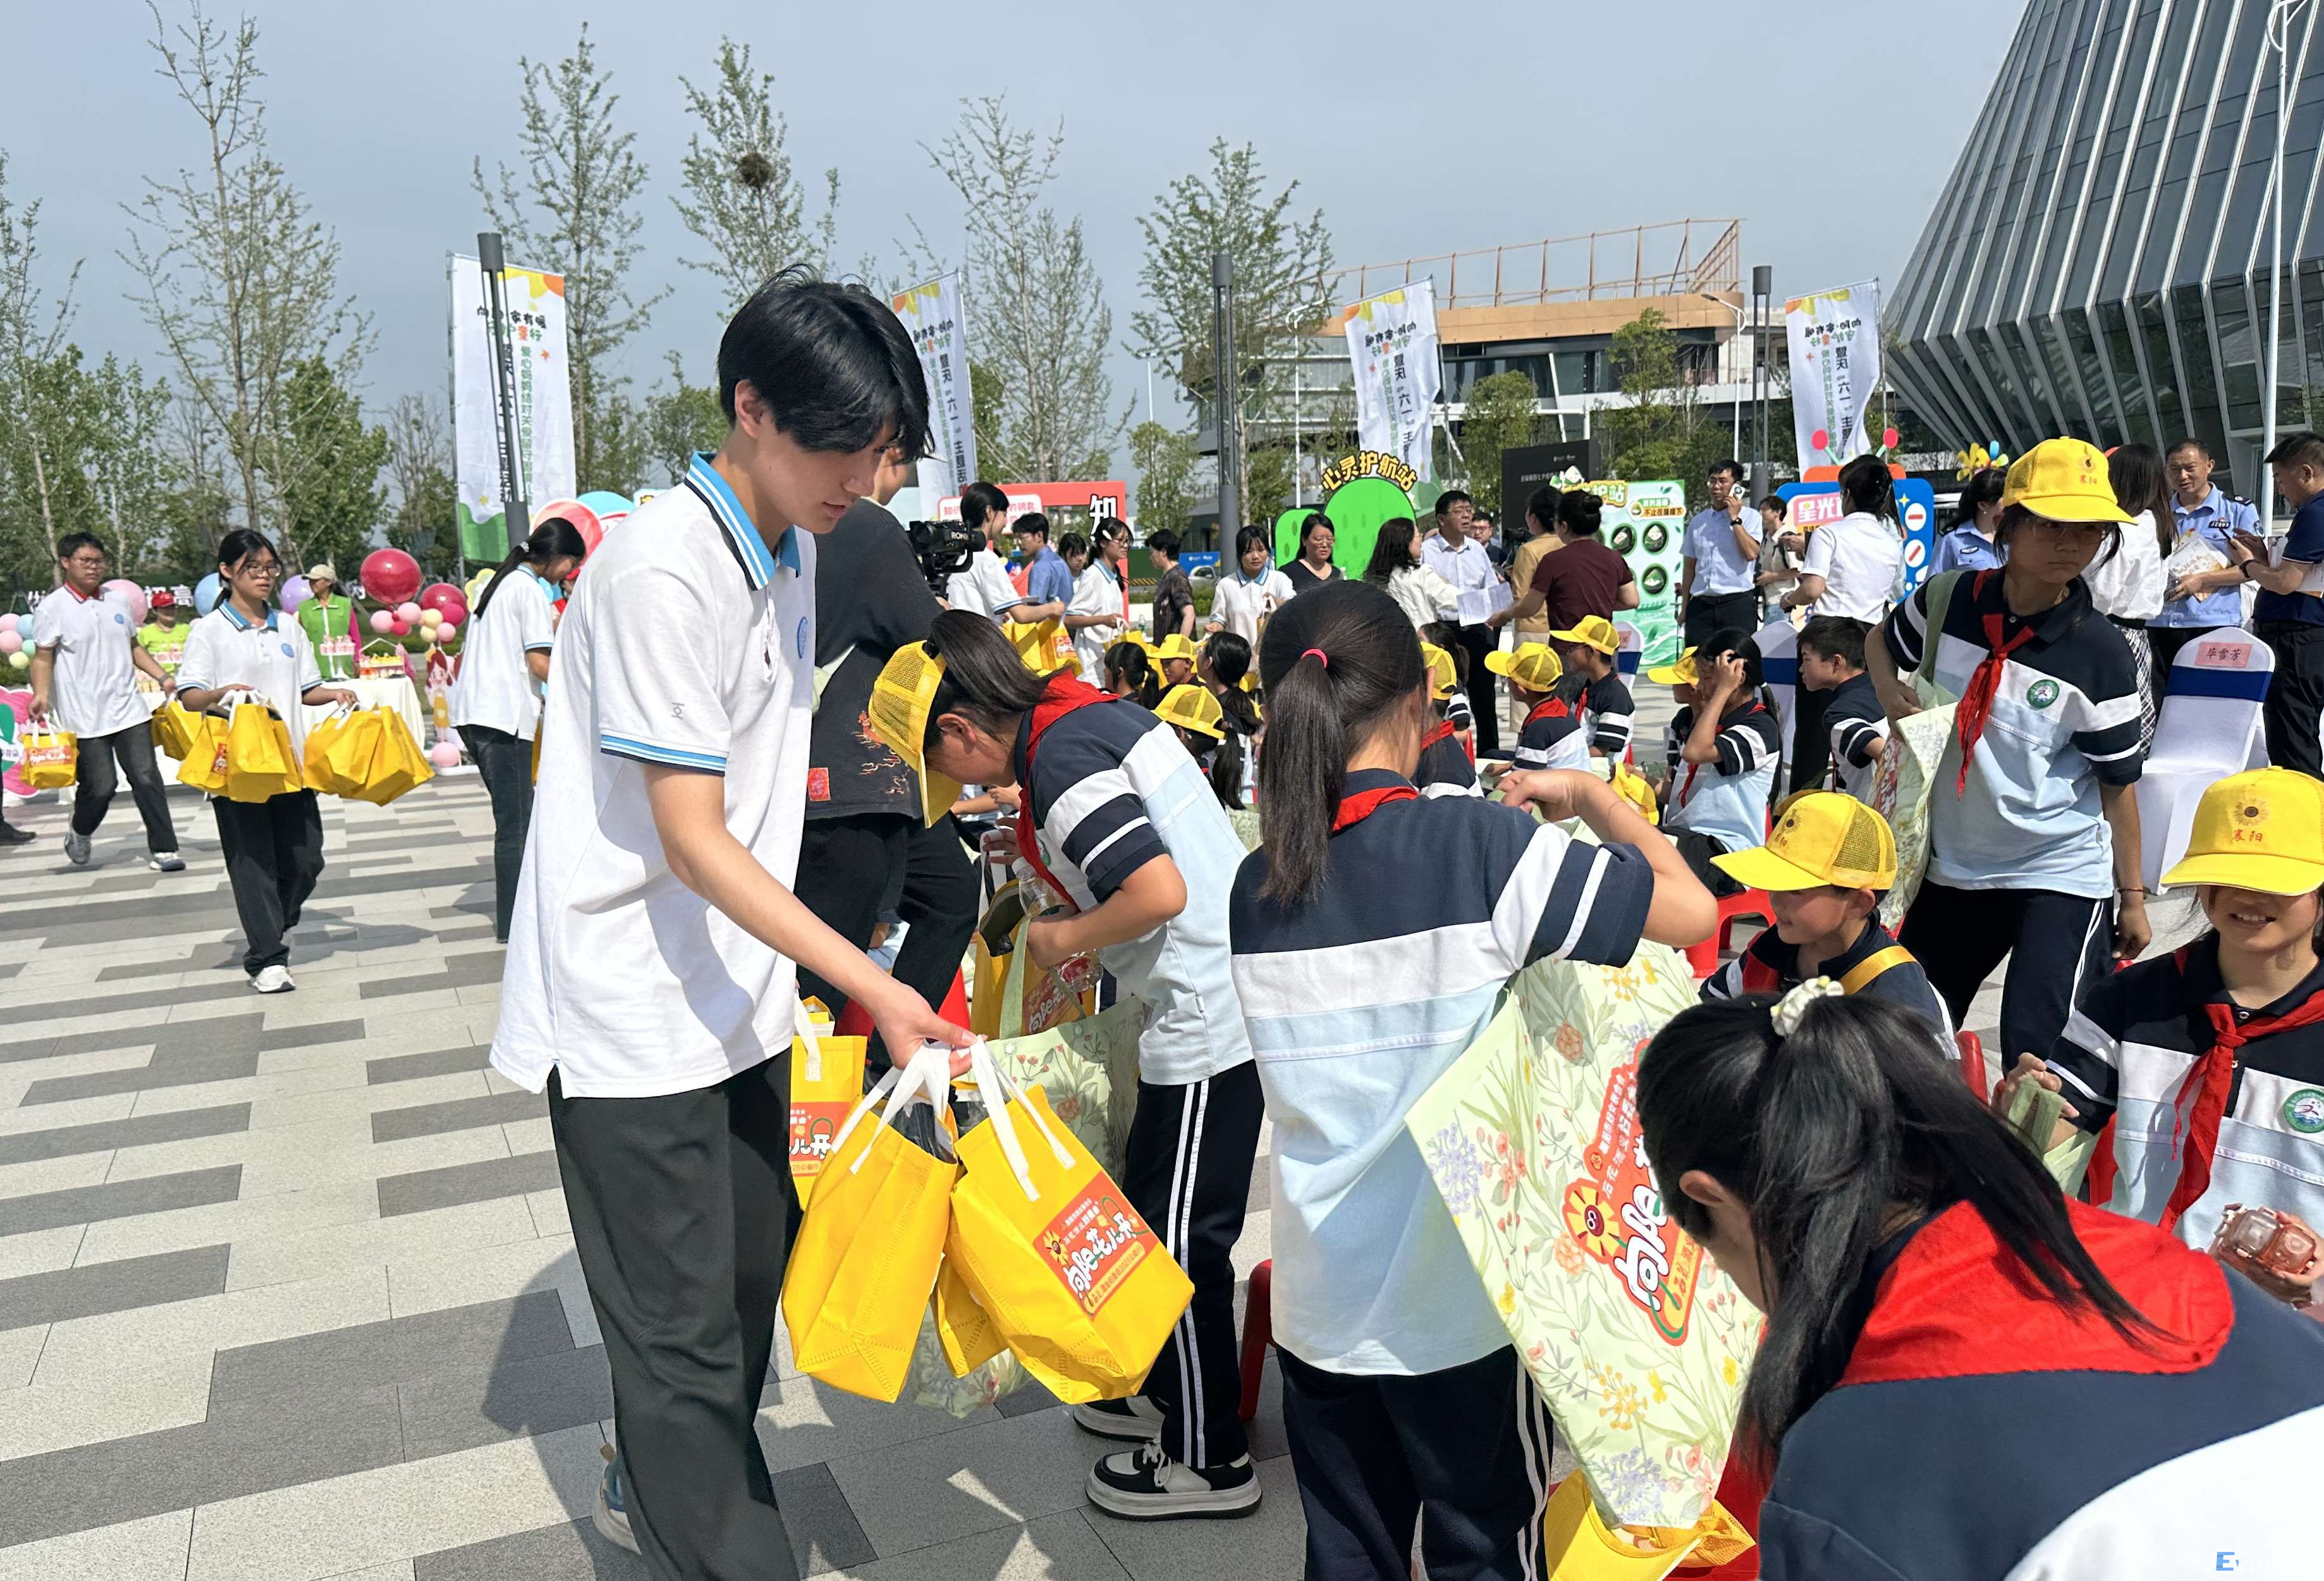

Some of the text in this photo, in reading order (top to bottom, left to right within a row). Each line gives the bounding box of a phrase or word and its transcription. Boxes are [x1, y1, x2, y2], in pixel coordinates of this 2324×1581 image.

[1322, 451, 1417, 492] 心灵护航站
[1798, 495, 1843, 524] 星光
[1062, 1211, 1138, 1300] 向阳花儿开
